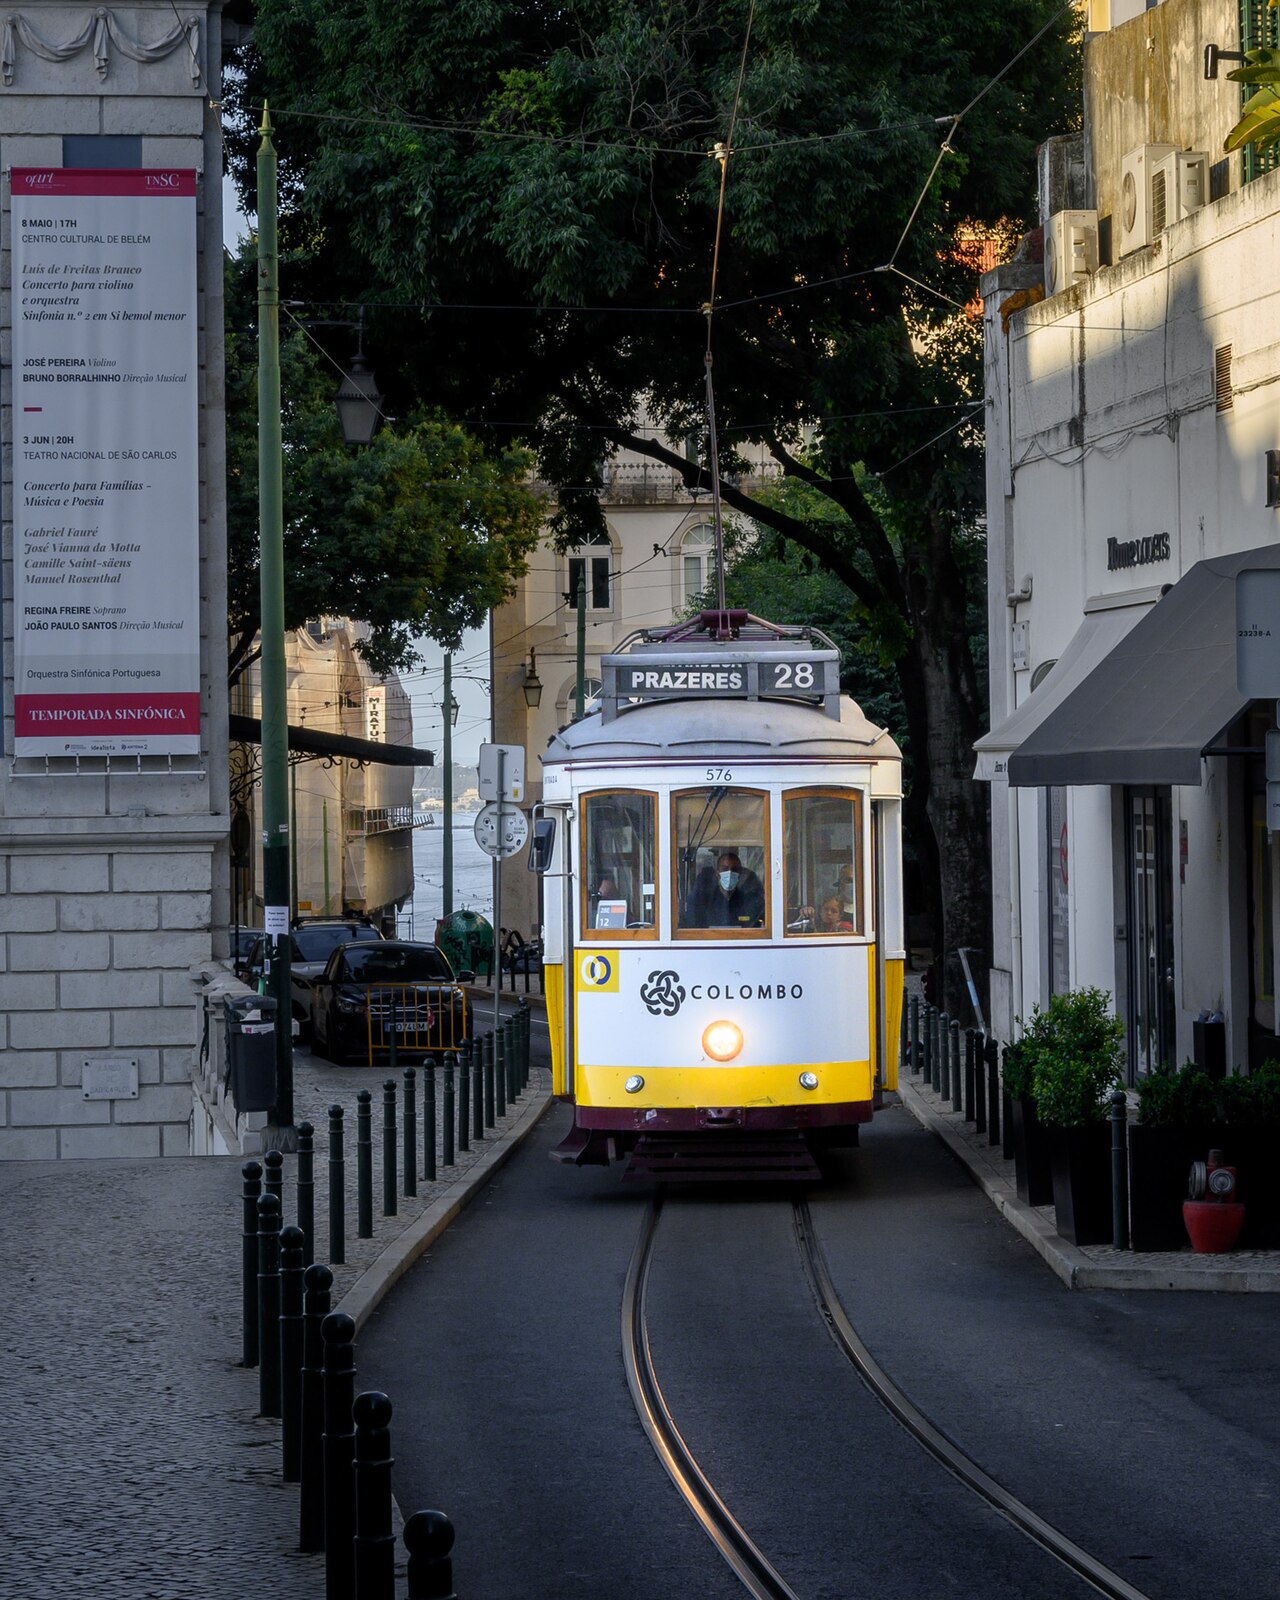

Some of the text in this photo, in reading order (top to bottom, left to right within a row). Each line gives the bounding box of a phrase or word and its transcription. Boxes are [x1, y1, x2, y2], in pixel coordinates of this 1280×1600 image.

[145, 173, 180, 187] TNSC
[21, 219, 28, 228] 8
[29, 219, 53, 228] MAIO
[60, 219, 77, 228] 17H
[21, 233, 151, 244] CENTRO CULTURAL DE BELÉM
[22, 264, 142, 275] Luís de Freitas Branco
[22, 279, 134, 292] Concerto para violino
[22, 295, 80, 307] e orquestra
[22, 310, 65, 323] Sinfonia
[84, 312, 91, 322] 2
[92, 313, 108, 321] em
[110, 310, 120, 321] Si
[122, 310, 152, 321] bemol
[153, 313, 186, 321] menor
[22, 357, 117, 367] JOSÉ PEREIRA Violino
[22, 373, 187, 384] BRUNO BORRALHINHO Direção Musical
[23, 436, 29, 445] 3
[30, 436, 50, 445] JUN
[56, 436, 74, 445] 20H
[23, 449, 177, 460] TEATRO NACIONAL DE SÃO CARLOS
[24, 481, 70, 491] Concerto
[72, 482, 97, 493] para
[99, 480, 144, 491] Famílias
[24, 495, 105, 507] Música e Poesia
[24, 526, 99, 538] Gabriel Fauré
[24, 542, 141, 555] José Vianna da Motta
[24, 558, 66, 569] Camille
[24, 573, 121, 584] Manuel Rosenthal
[24, 606, 127, 616] REGINA FREIRE Soprano
[24, 620, 183, 632] JOÃO PAULO SANTOS Direção Musical
[26, 668, 161, 680] Orquestra Sinfónica Portuguesa
[631, 663, 815, 690] PRAZERES 28
[29, 706, 186, 721] TEMPORADA SINFÓNICA
[706, 769, 732, 782] 576
[691, 984, 803, 1000] COLOMBO
